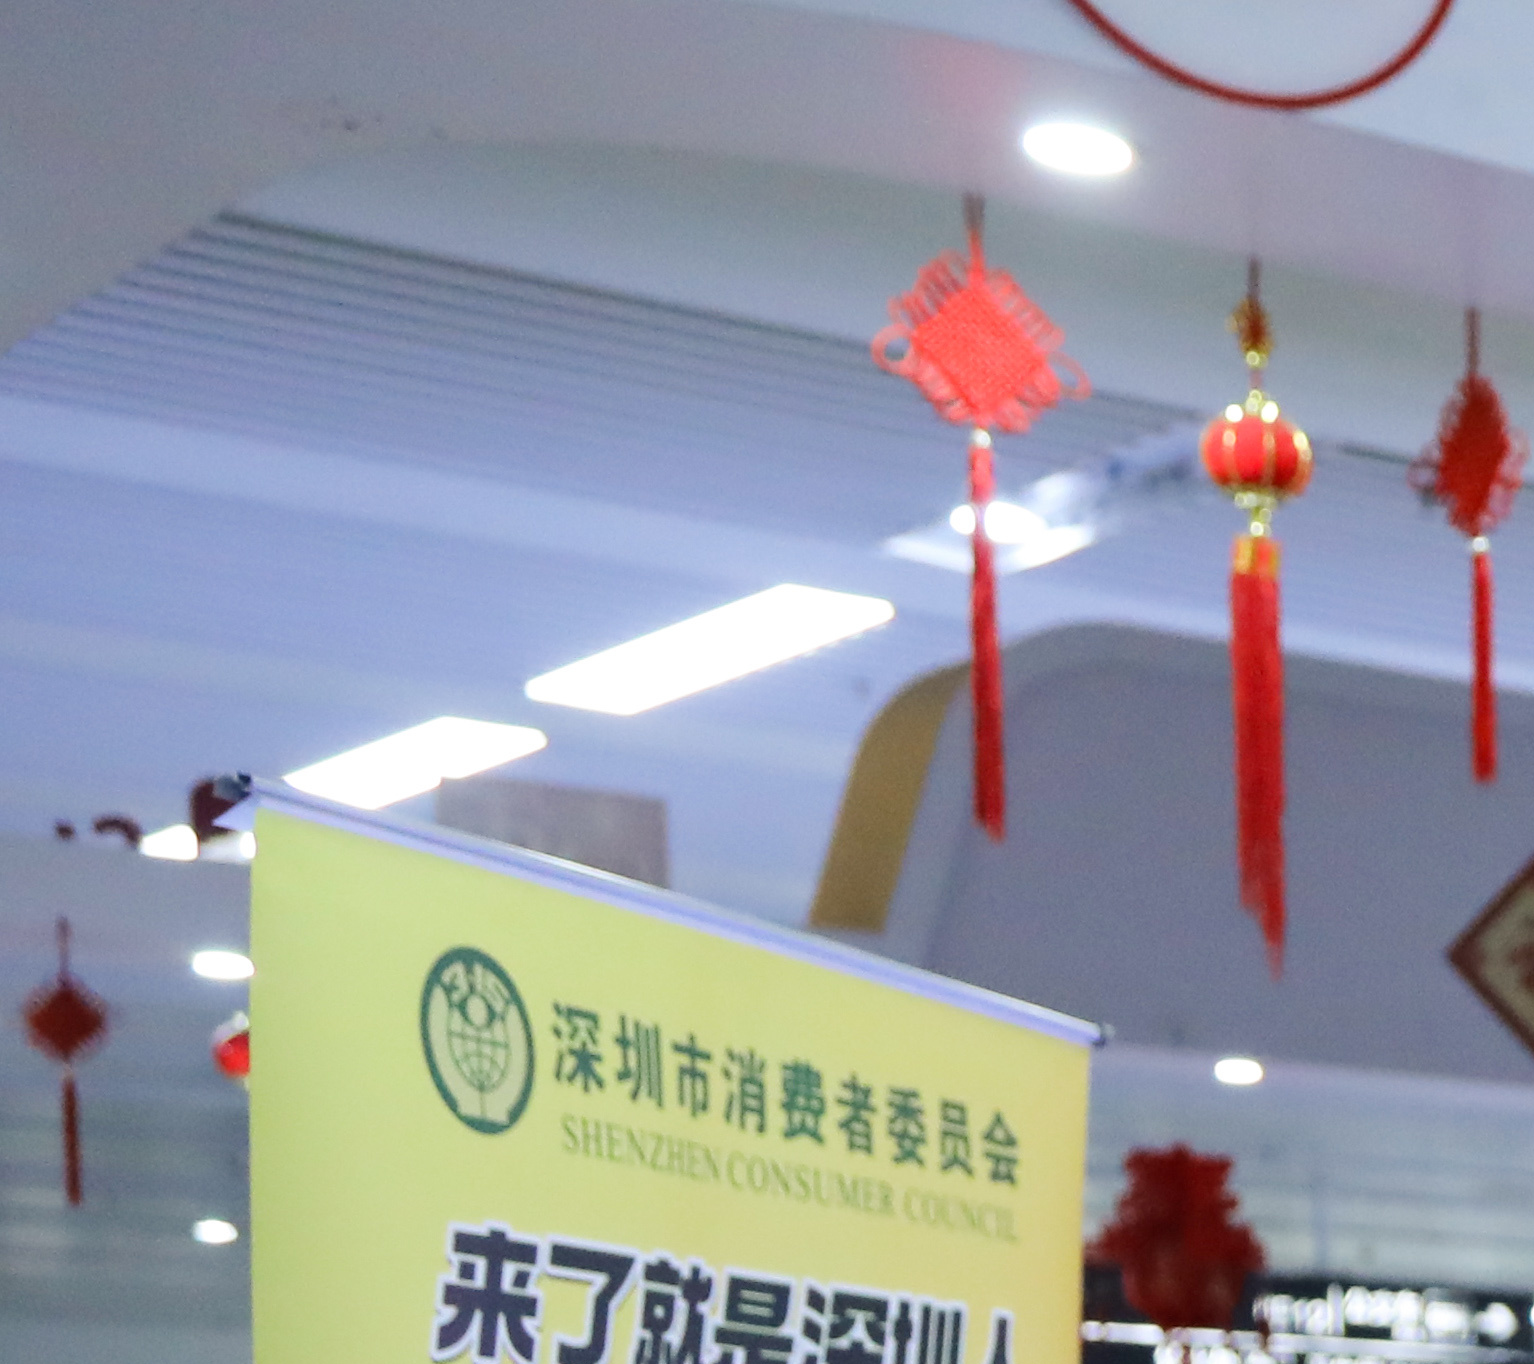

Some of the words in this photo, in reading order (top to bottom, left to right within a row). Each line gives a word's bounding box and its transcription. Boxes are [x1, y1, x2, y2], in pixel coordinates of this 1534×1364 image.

[549, 1000, 1021, 1189] 深圳市消费者委员会
[560, 1113, 723, 1181] SHENZHEN
[727, 1152, 895, 1219] CONSUMER
[904, 1186, 1018, 1244] COUNCIL
